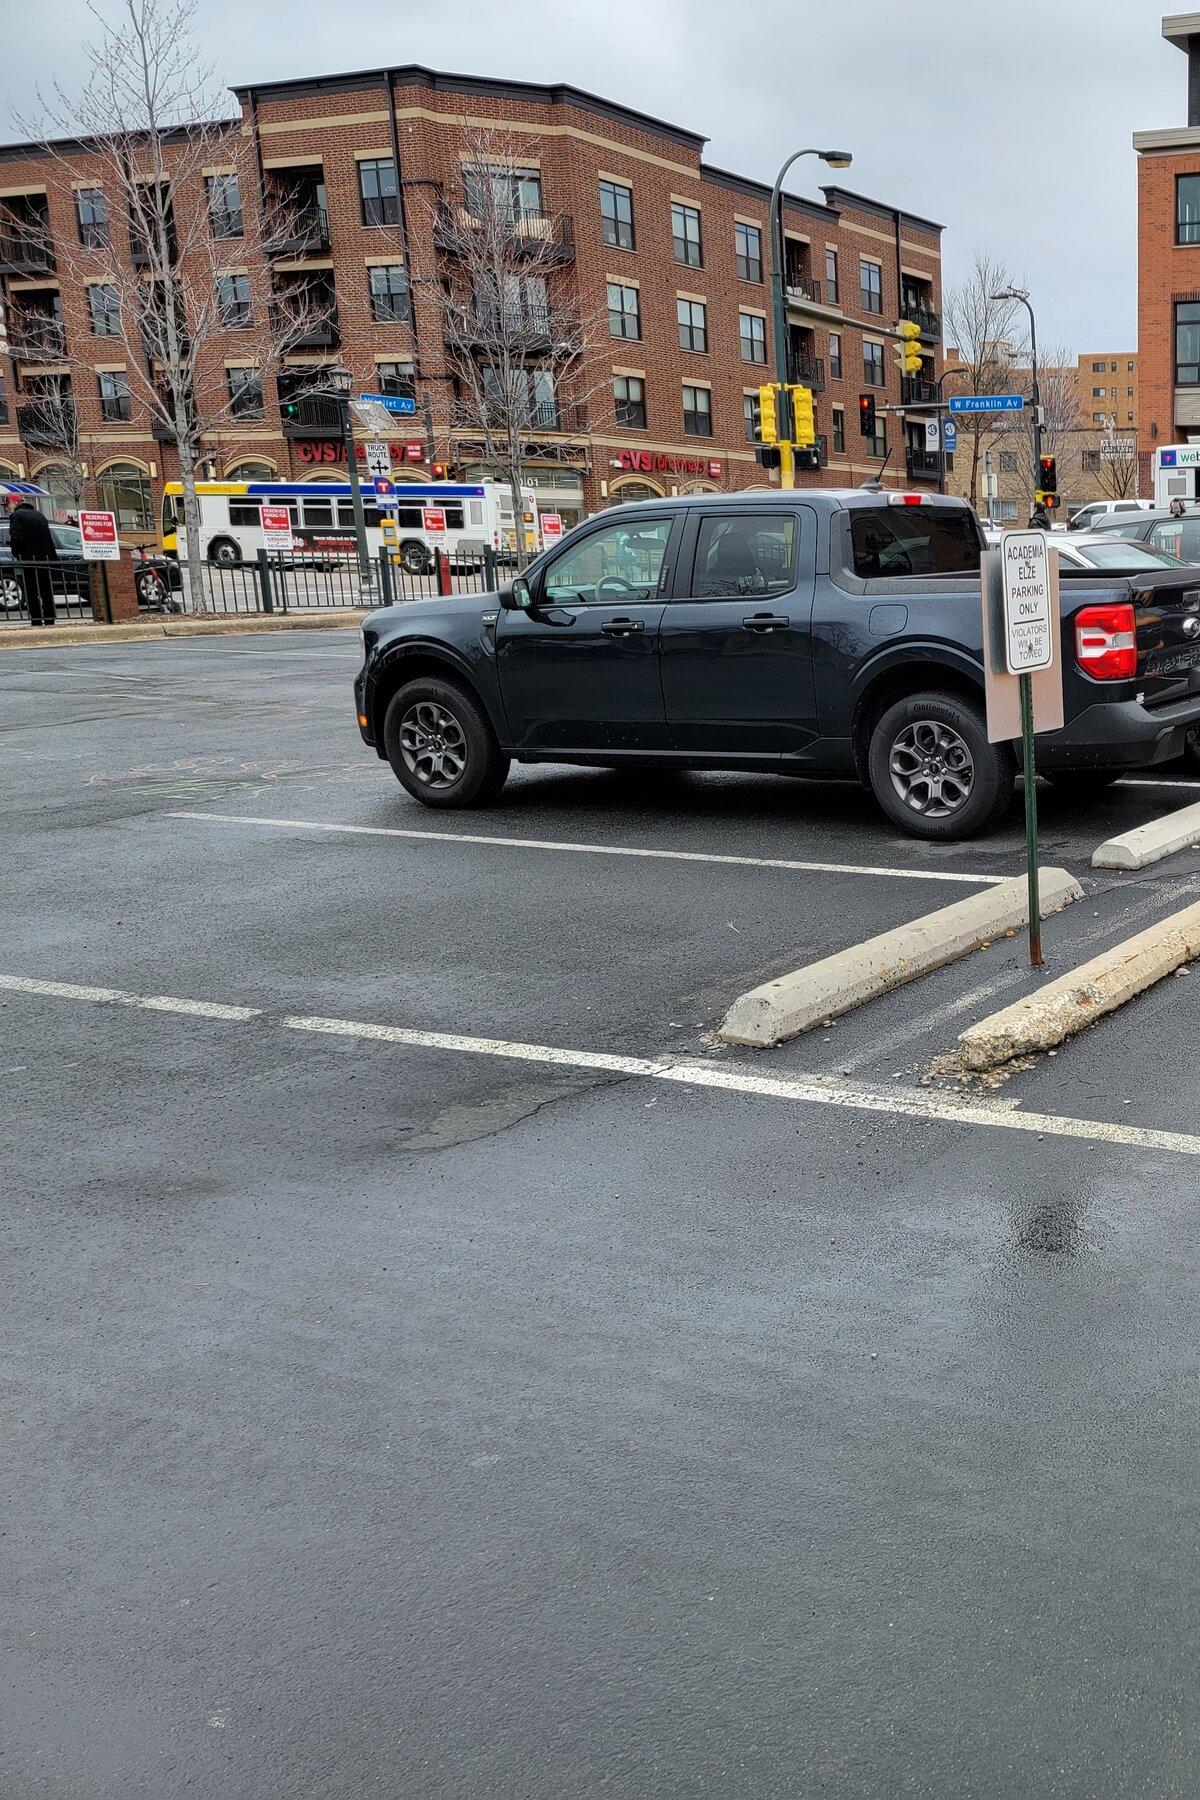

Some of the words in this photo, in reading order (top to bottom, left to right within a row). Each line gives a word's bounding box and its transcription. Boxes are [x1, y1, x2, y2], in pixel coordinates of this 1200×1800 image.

[401, 401, 411, 409] Av
[954, 401, 962, 409] W
[965, 399, 1002, 409] Franklin
[1006, 398, 1018, 407] Av
[367, 444, 387, 452] TRUCK
[368, 451, 388, 459] ROUTE
[1007, 545, 1044, 561] ACADEMIA
[1018, 565, 1036, 580] ELZE
[1011, 584, 1044, 599] PARKING
[1019, 602, 1039, 615] ONLY
[1011, 624, 1047, 638] VIOLATORS
[1018, 638, 1033, 650] WILL
[1034, 637, 1043, 646] BE
[1019, 648, 1043, 660] TOWED
[914, 703, 955, 719] Continental
